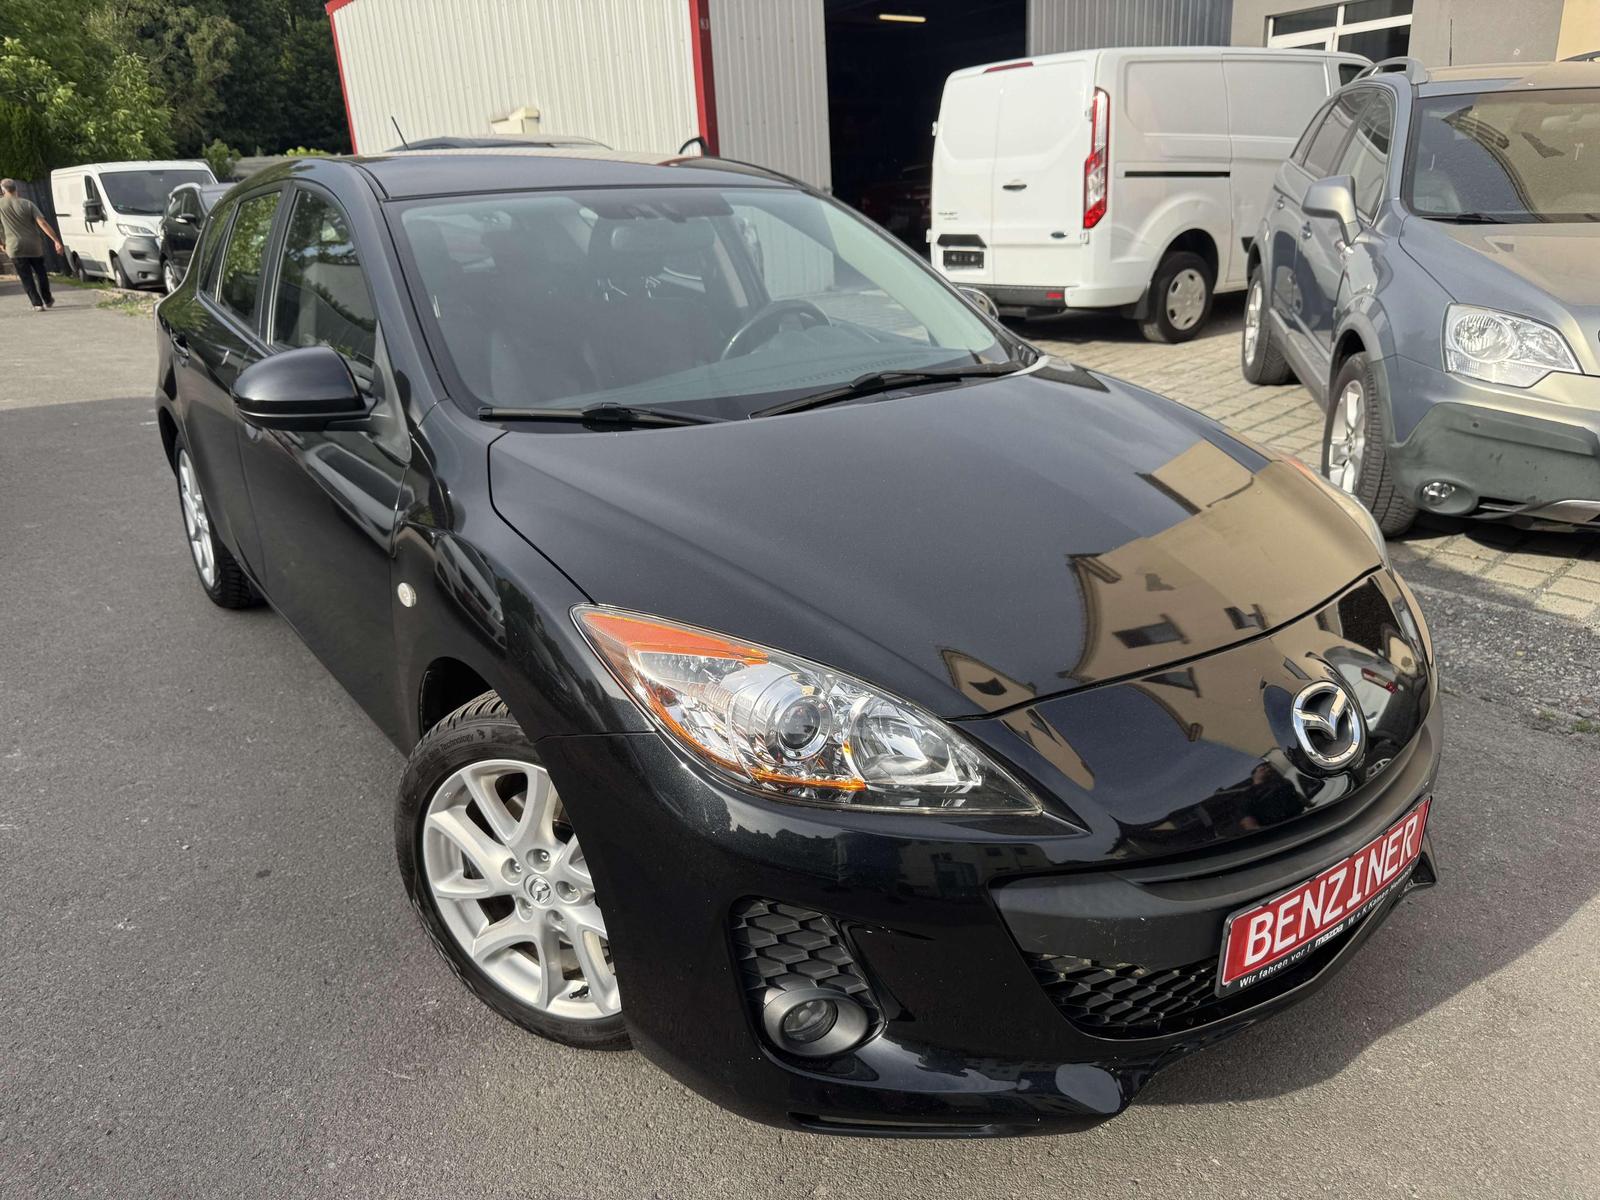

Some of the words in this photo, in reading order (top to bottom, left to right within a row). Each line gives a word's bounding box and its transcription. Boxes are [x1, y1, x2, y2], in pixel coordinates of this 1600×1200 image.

[1244, 814, 1418, 966] BENZINER
[1239, 974, 1256, 988] Wir
[1259, 958, 1288, 979] fahren
[1291, 947, 1305, 961] vor
[1315, 923, 1344, 948] mazda
